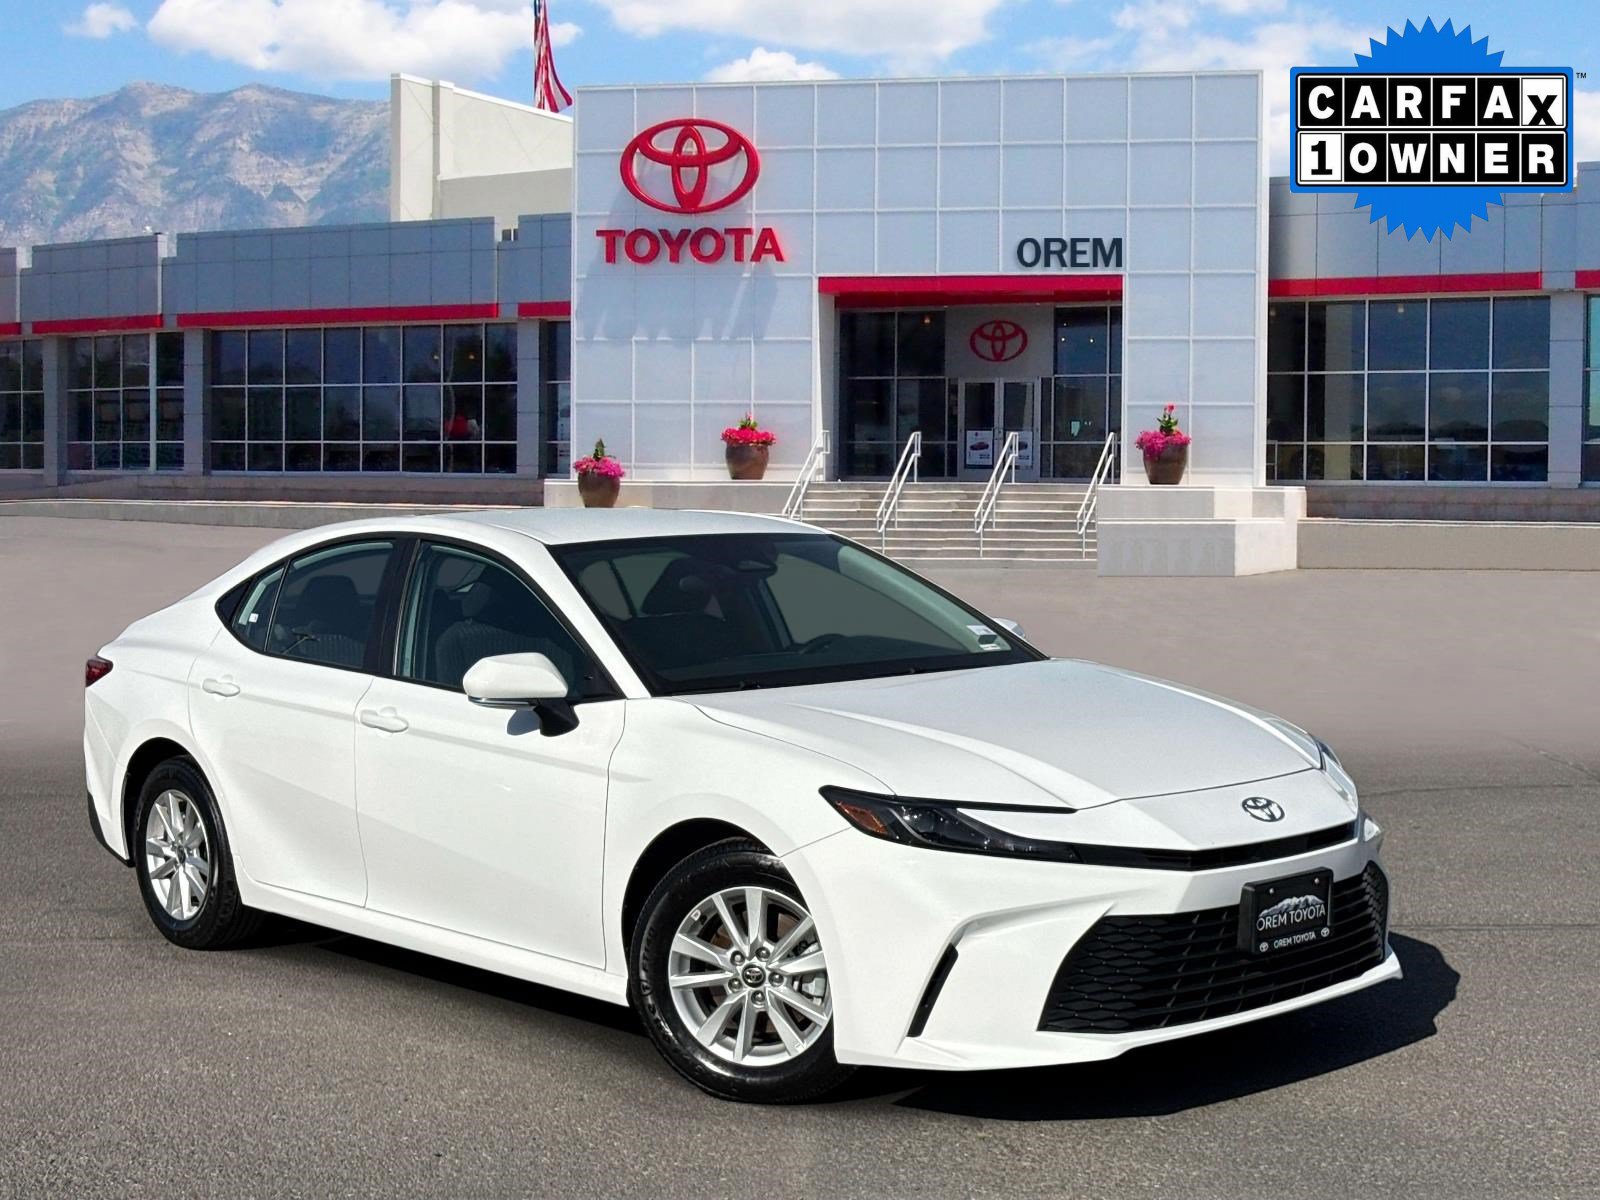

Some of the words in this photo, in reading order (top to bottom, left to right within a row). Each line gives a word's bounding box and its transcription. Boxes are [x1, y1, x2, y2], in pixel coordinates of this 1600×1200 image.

[596, 227, 785, 265] TOYOTA
[1017, 237, 1123, 268] OREM
[1256, 912, 1287, 931] OREM
[1289, 903, 1326, 924] TOYOTA
[1273, 936, 1292, 949] OREM
[1292, 931, 1316, 944] TOYOTA
